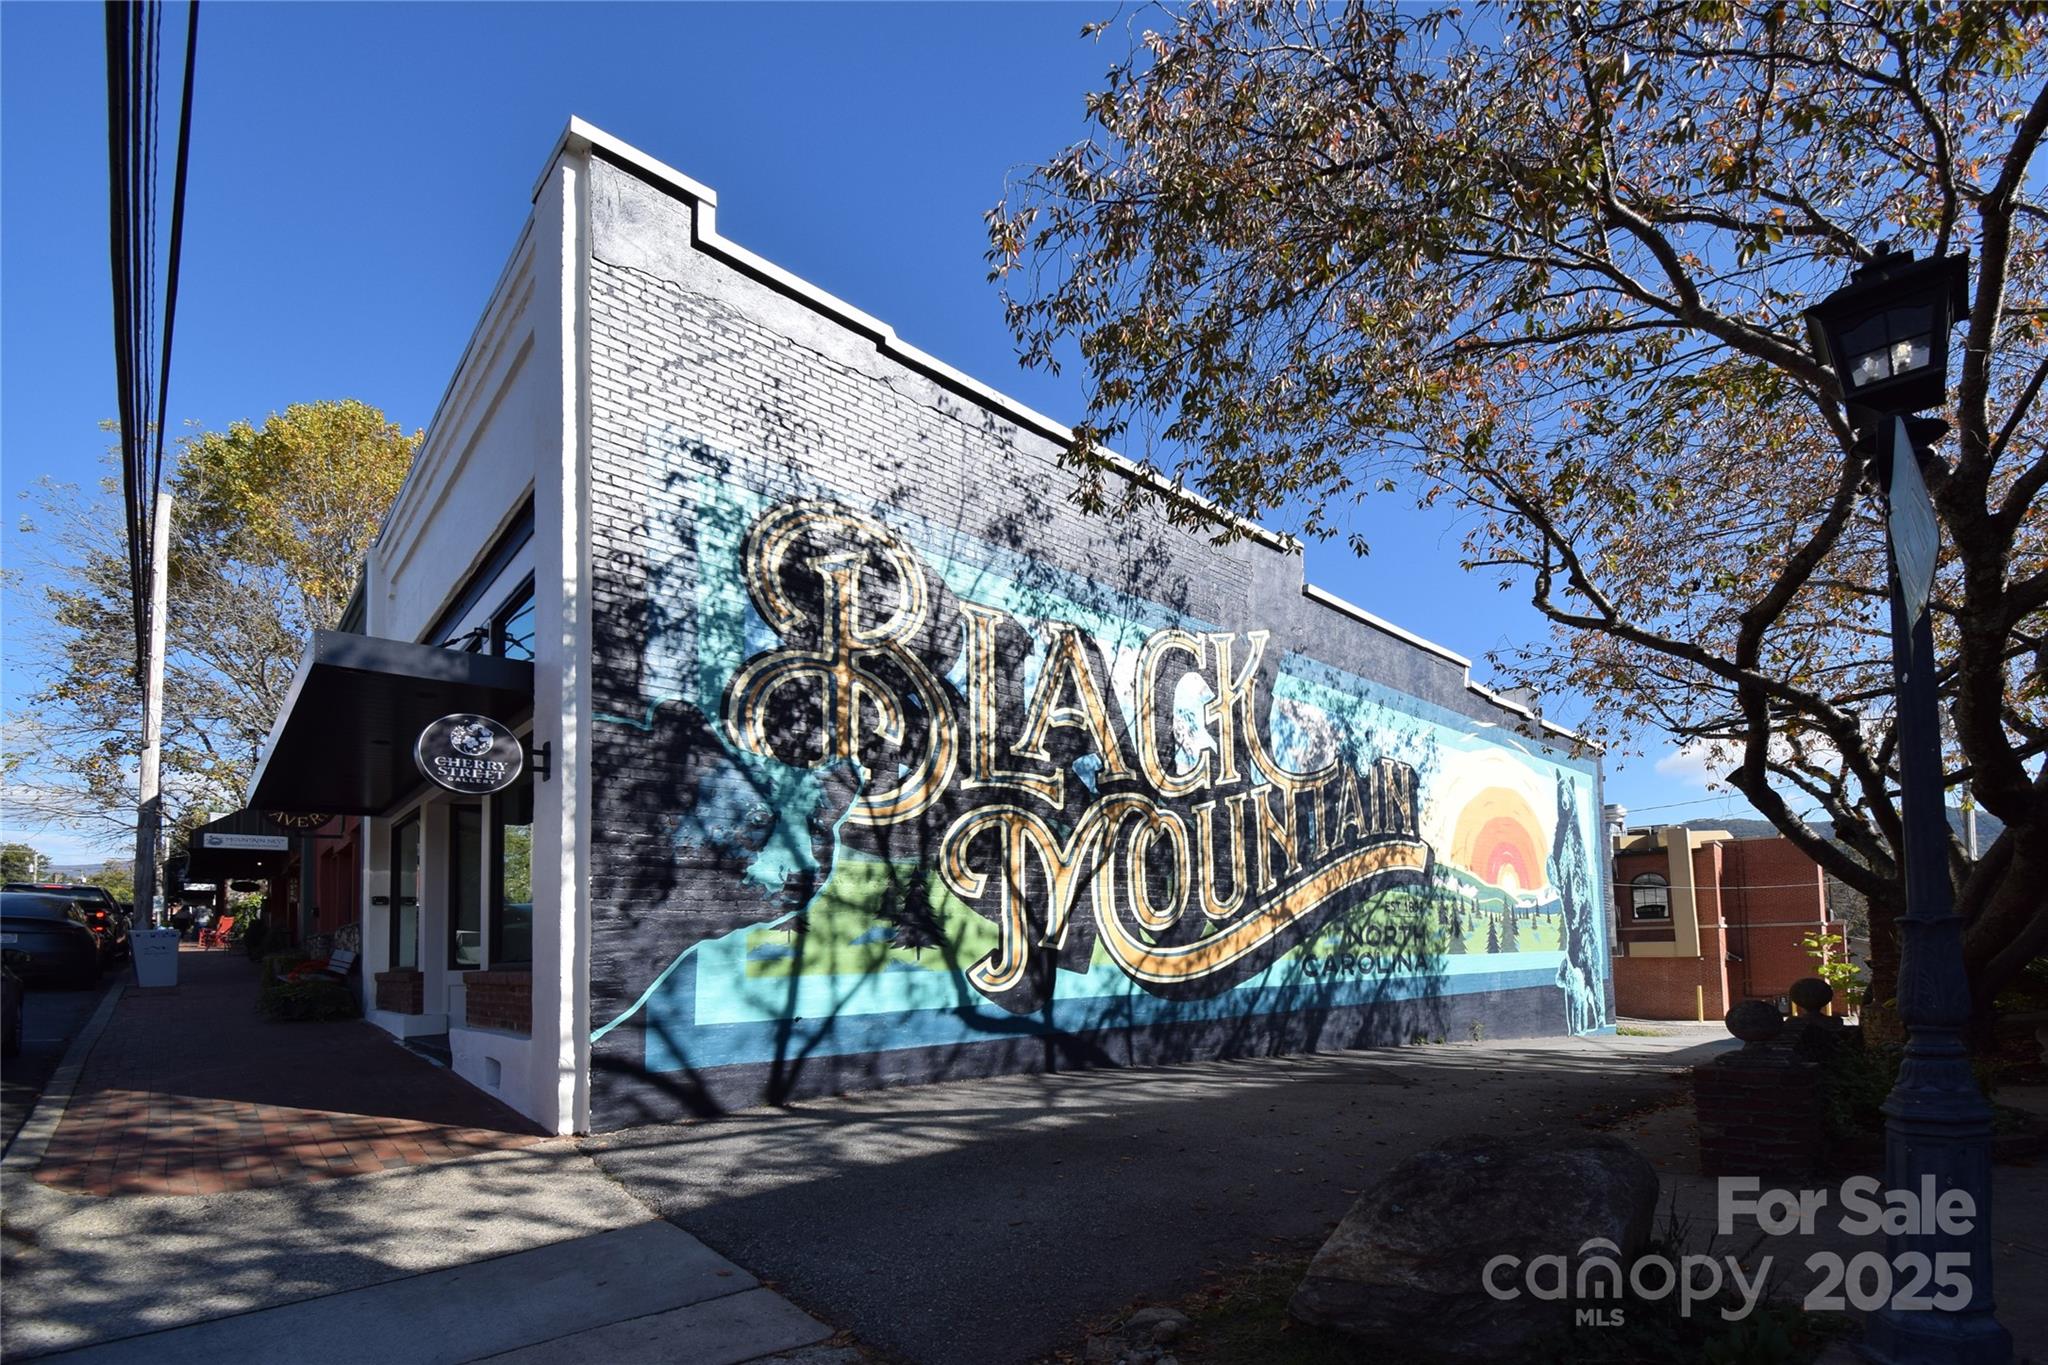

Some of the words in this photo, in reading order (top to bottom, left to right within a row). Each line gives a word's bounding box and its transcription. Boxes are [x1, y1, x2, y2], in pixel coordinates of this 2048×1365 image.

[725, 502, 1338, 825] BLACK
[434, 756, 508, 771] CHERRY
[437, 766, 505, 780] STREET
[447, 776, 496, 785] GALLERY
[939, 758, 1428, 993] MOUNTAIN
[1343, 922, 1427, 946] NORTH
[1302, 952, 1428, 977] CAROLINA
